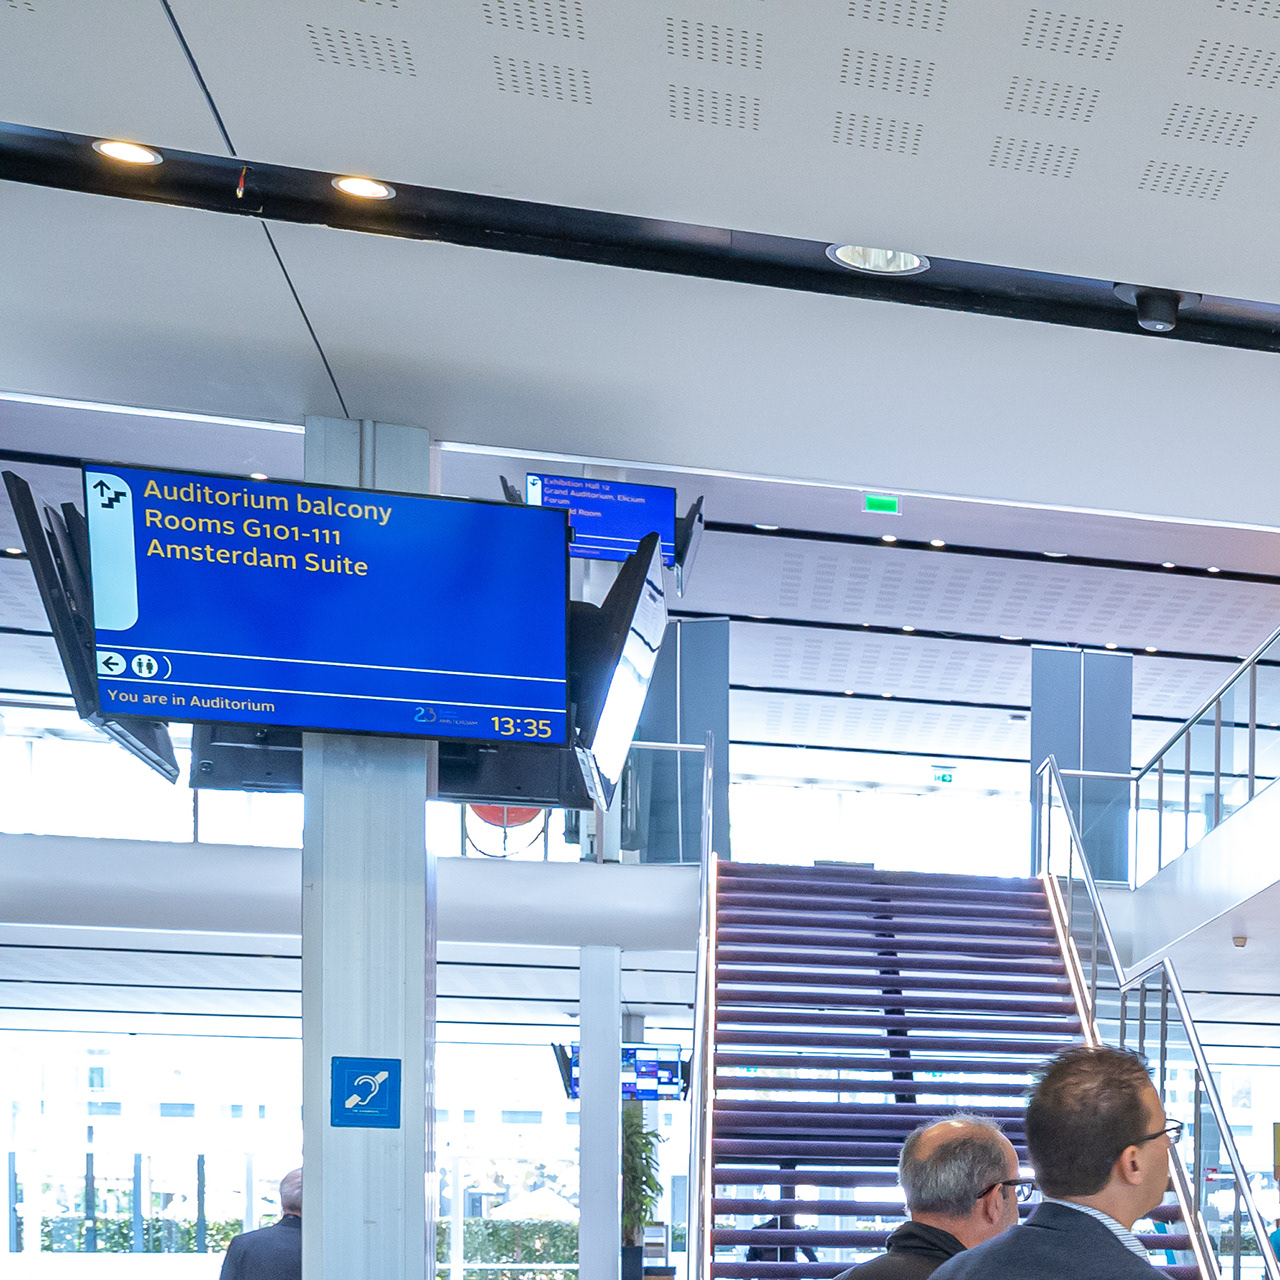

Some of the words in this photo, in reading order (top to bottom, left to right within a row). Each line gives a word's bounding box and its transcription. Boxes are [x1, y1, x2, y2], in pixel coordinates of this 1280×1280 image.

[143, 479, 289, 511] Auditorium
[297, 493, 392, 526] balcony
[145, 509, 235, 535] Rooms
[243, 519, 341, 545] G101-111
[147, 538, 297, 570] Amsterdam
[305, 553, 368, 576] Suite
[107, 689, 138, 703] You
[143, 693, 168, 705] are
[172, 693, 186, 706] in
[190, 695, 275, 712] Auditorium
[491, 716, 552, 738] 13:35
